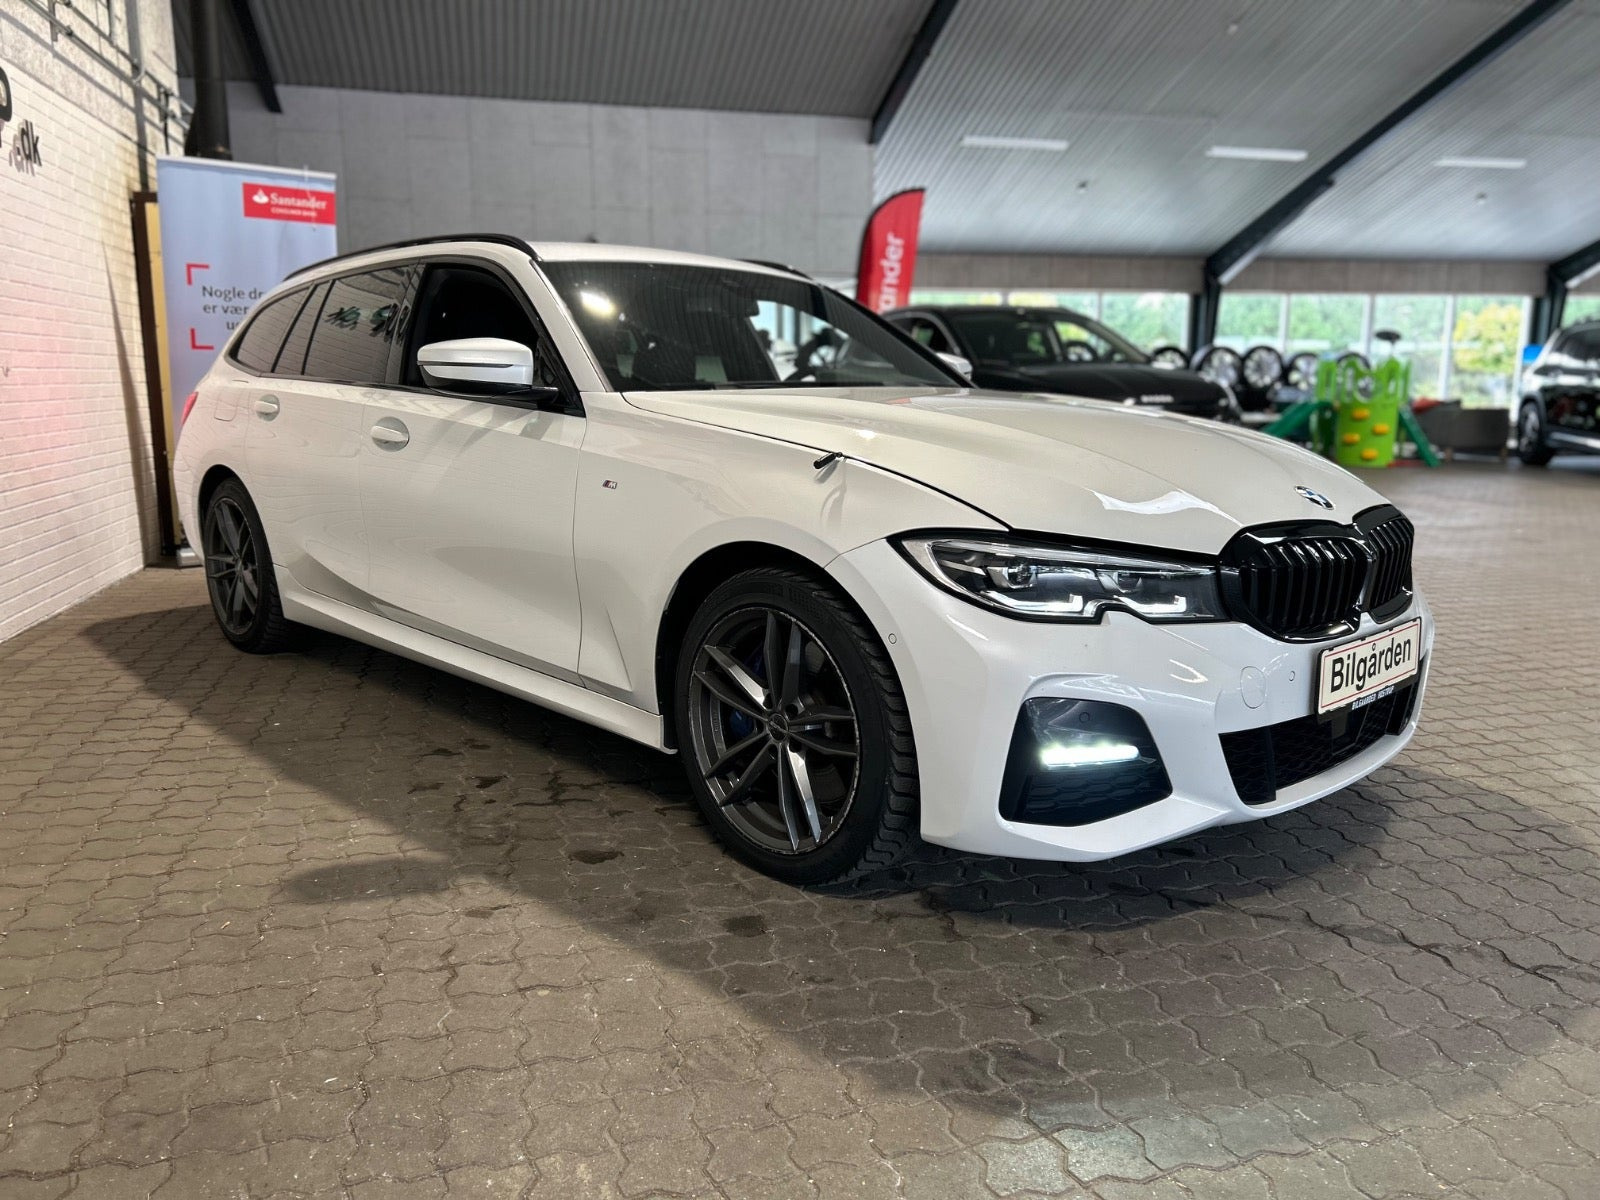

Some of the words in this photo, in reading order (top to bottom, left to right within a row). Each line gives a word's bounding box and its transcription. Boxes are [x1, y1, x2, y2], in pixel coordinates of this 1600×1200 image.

[270, 192, 327, 210] Santander
[202, 285, 246, 302] Nogle
[203, 303, 218, 314] er
[221, 304, 249, 315] vær
[1330, 637, 1412, 693] Bilgården
